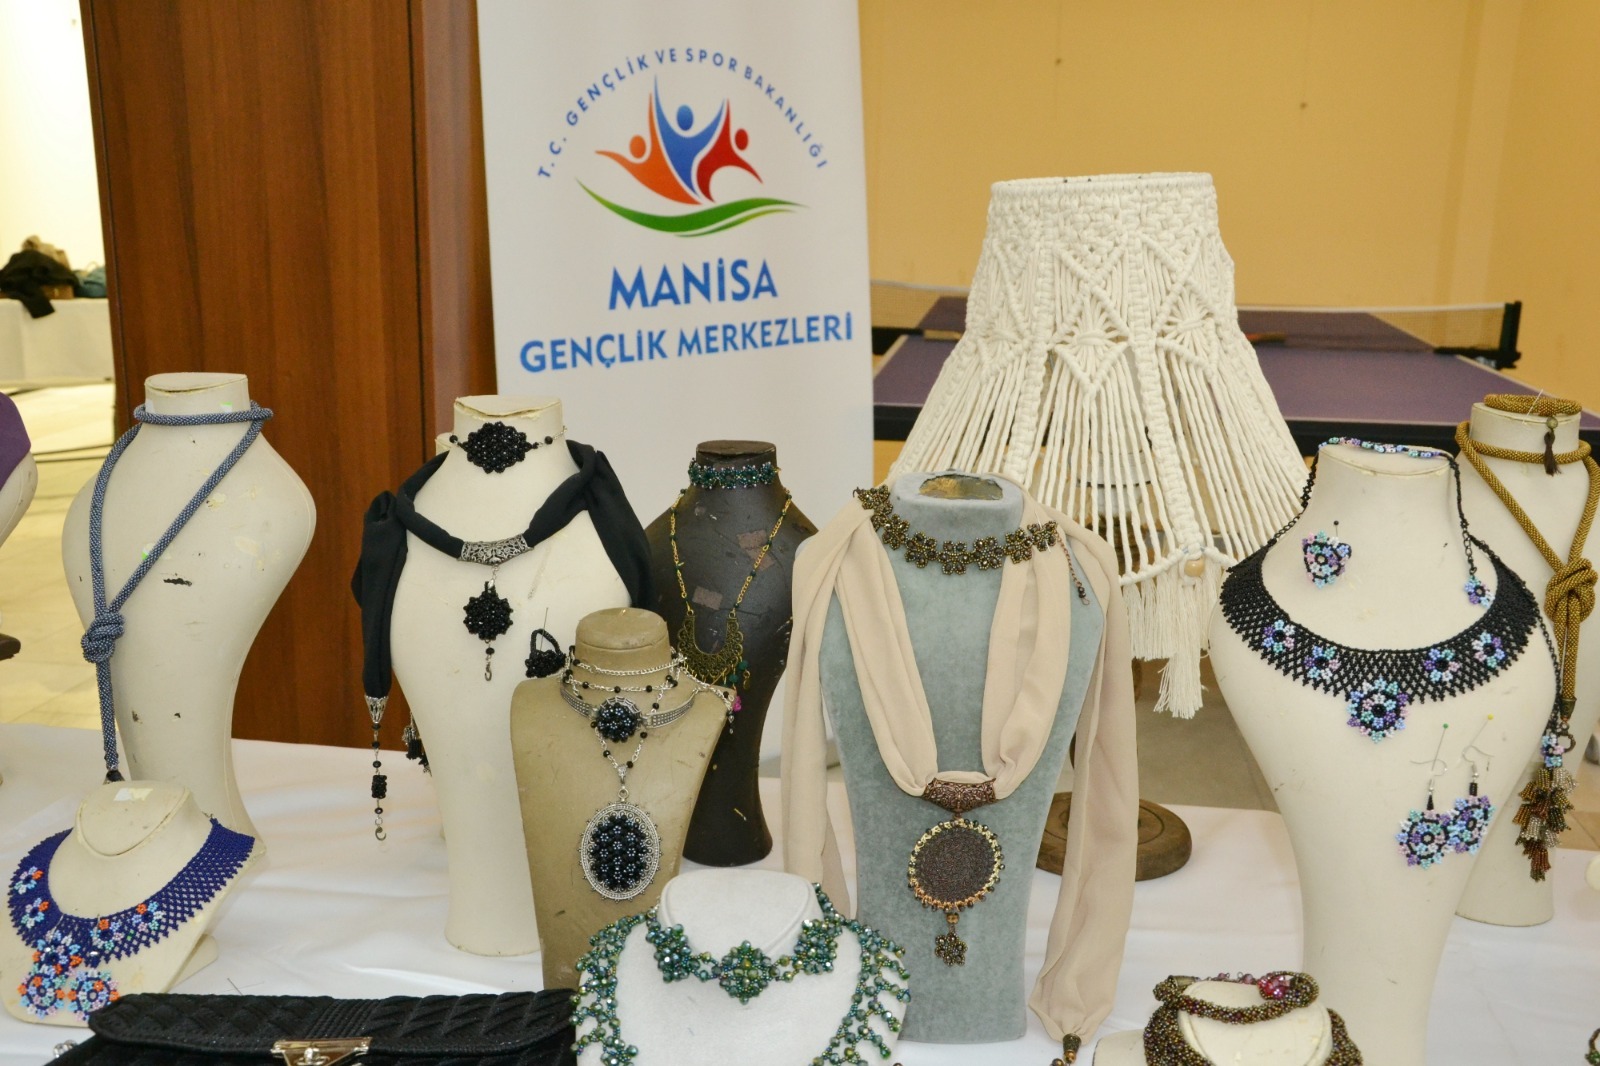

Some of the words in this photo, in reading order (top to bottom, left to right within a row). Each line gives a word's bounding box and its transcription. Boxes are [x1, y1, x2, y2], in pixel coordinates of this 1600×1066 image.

[566, 54, 649, 126] GENÇLİK
[655, 48, 678, 64] VE
[685, 47, 738, 71] SPOR
[743, 66, 828, 169] BAKANLIĞI
[608, 257, 778, 311] MANİSA
[519, 329, 668, 373] GENÇLİK
[677, 312, 853, 357] MERKEZLERİ
